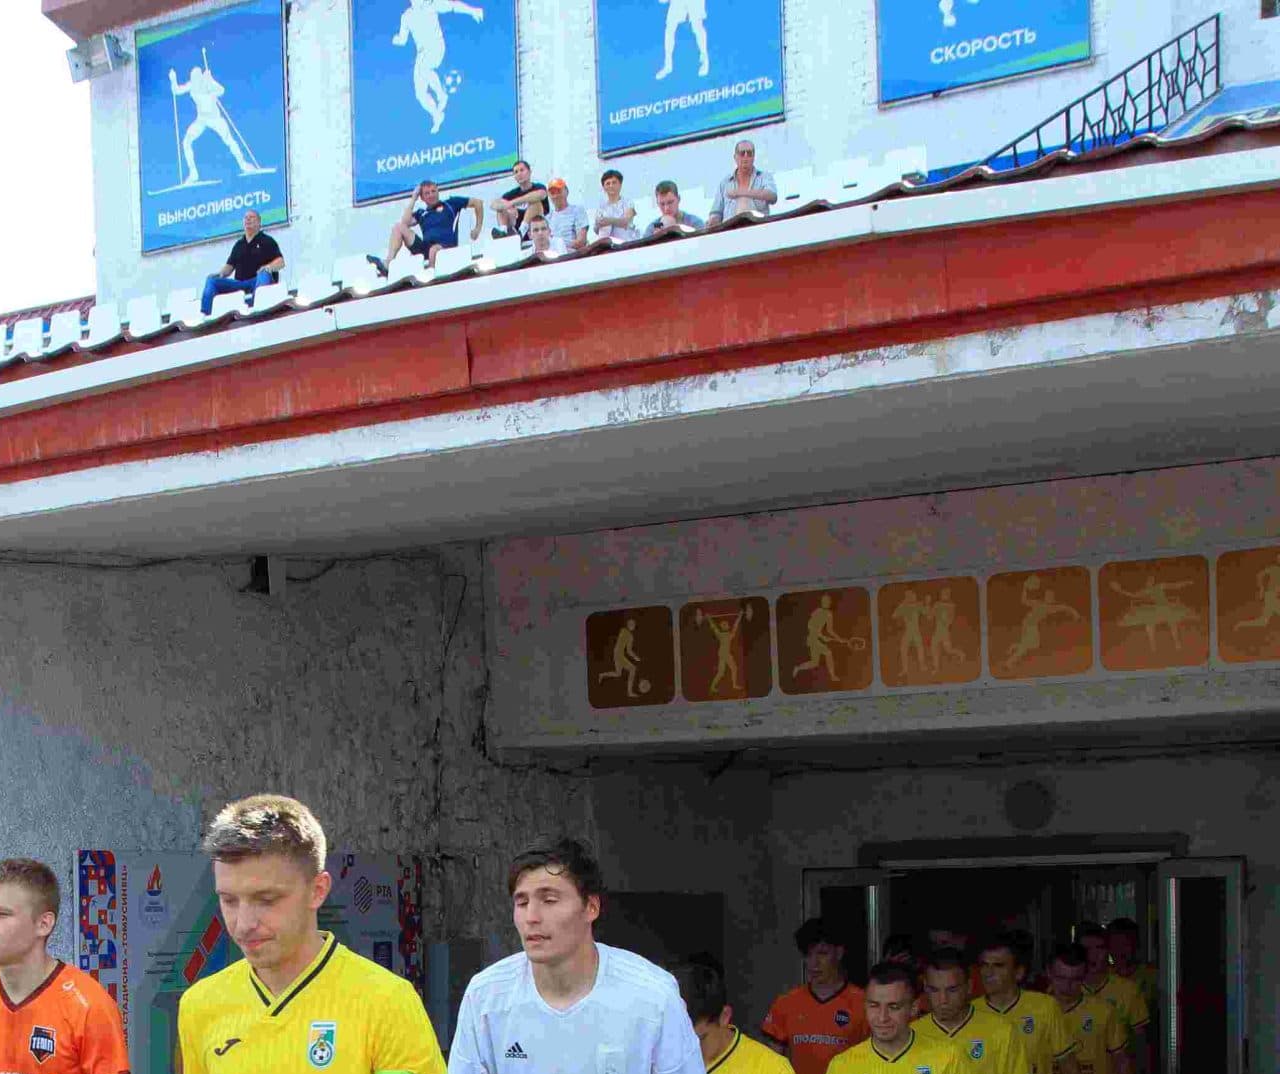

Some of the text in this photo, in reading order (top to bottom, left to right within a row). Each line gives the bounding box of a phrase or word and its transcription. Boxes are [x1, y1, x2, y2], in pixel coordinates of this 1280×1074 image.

[929, 27, 1037, 64] СКОРОСТЬ
[609, 76, 773, 126] ЦЕЛЕУСТРЕМЛЕННОСТЬ
[376, 136, 496, 173] КОМАНДНОСТЬ
[158, 190, 271, 227] ВЫНОСЛИВОСТЬ
